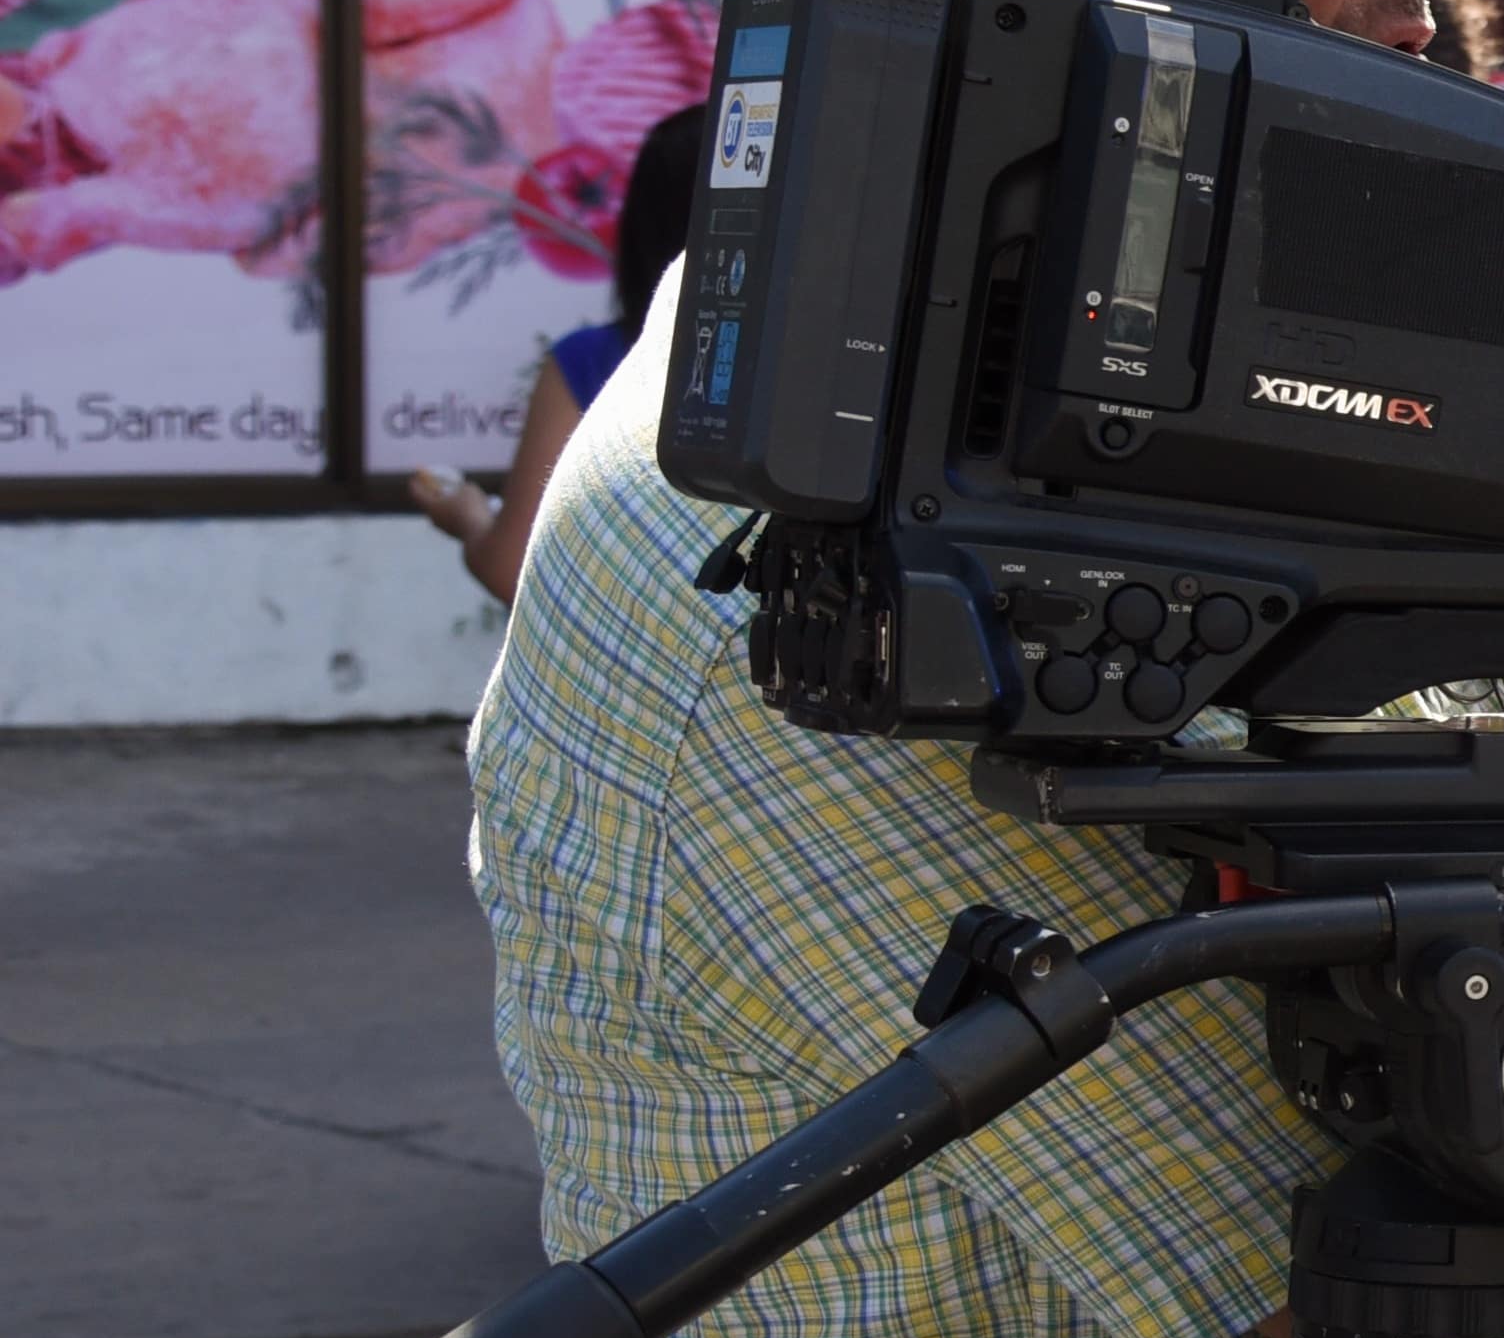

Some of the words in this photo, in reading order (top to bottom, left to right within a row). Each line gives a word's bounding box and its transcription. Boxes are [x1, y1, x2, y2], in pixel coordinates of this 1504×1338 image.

[725, 112, 742, 146] BT
[744, 143, 766, 178] City
[1185, 172, 1214, 187] OPEN
[846, 338, 877, 352] LOCK
[1251, 374, 1384, 421] XDCAM
[1386, 397, 1435, 429] EX
[77, 392, 222, 443] Same
[384, 392, 524, 439] delive
[1121, 405, 1154, 420] SELECT
[1002, 564, 1026, 574] HDMI
[1080, 570, 1126, 581] GENLOCK
[1098, 579, 1109, 588] IN
[1168, 603, 1180, 613] TC
[1182, 603, 1193, 613] IN
[1025, 650, 1047, 660] OUT
[1109, 662, 1121, 672] TC
[1104, 671, 1125, 680] OUT
